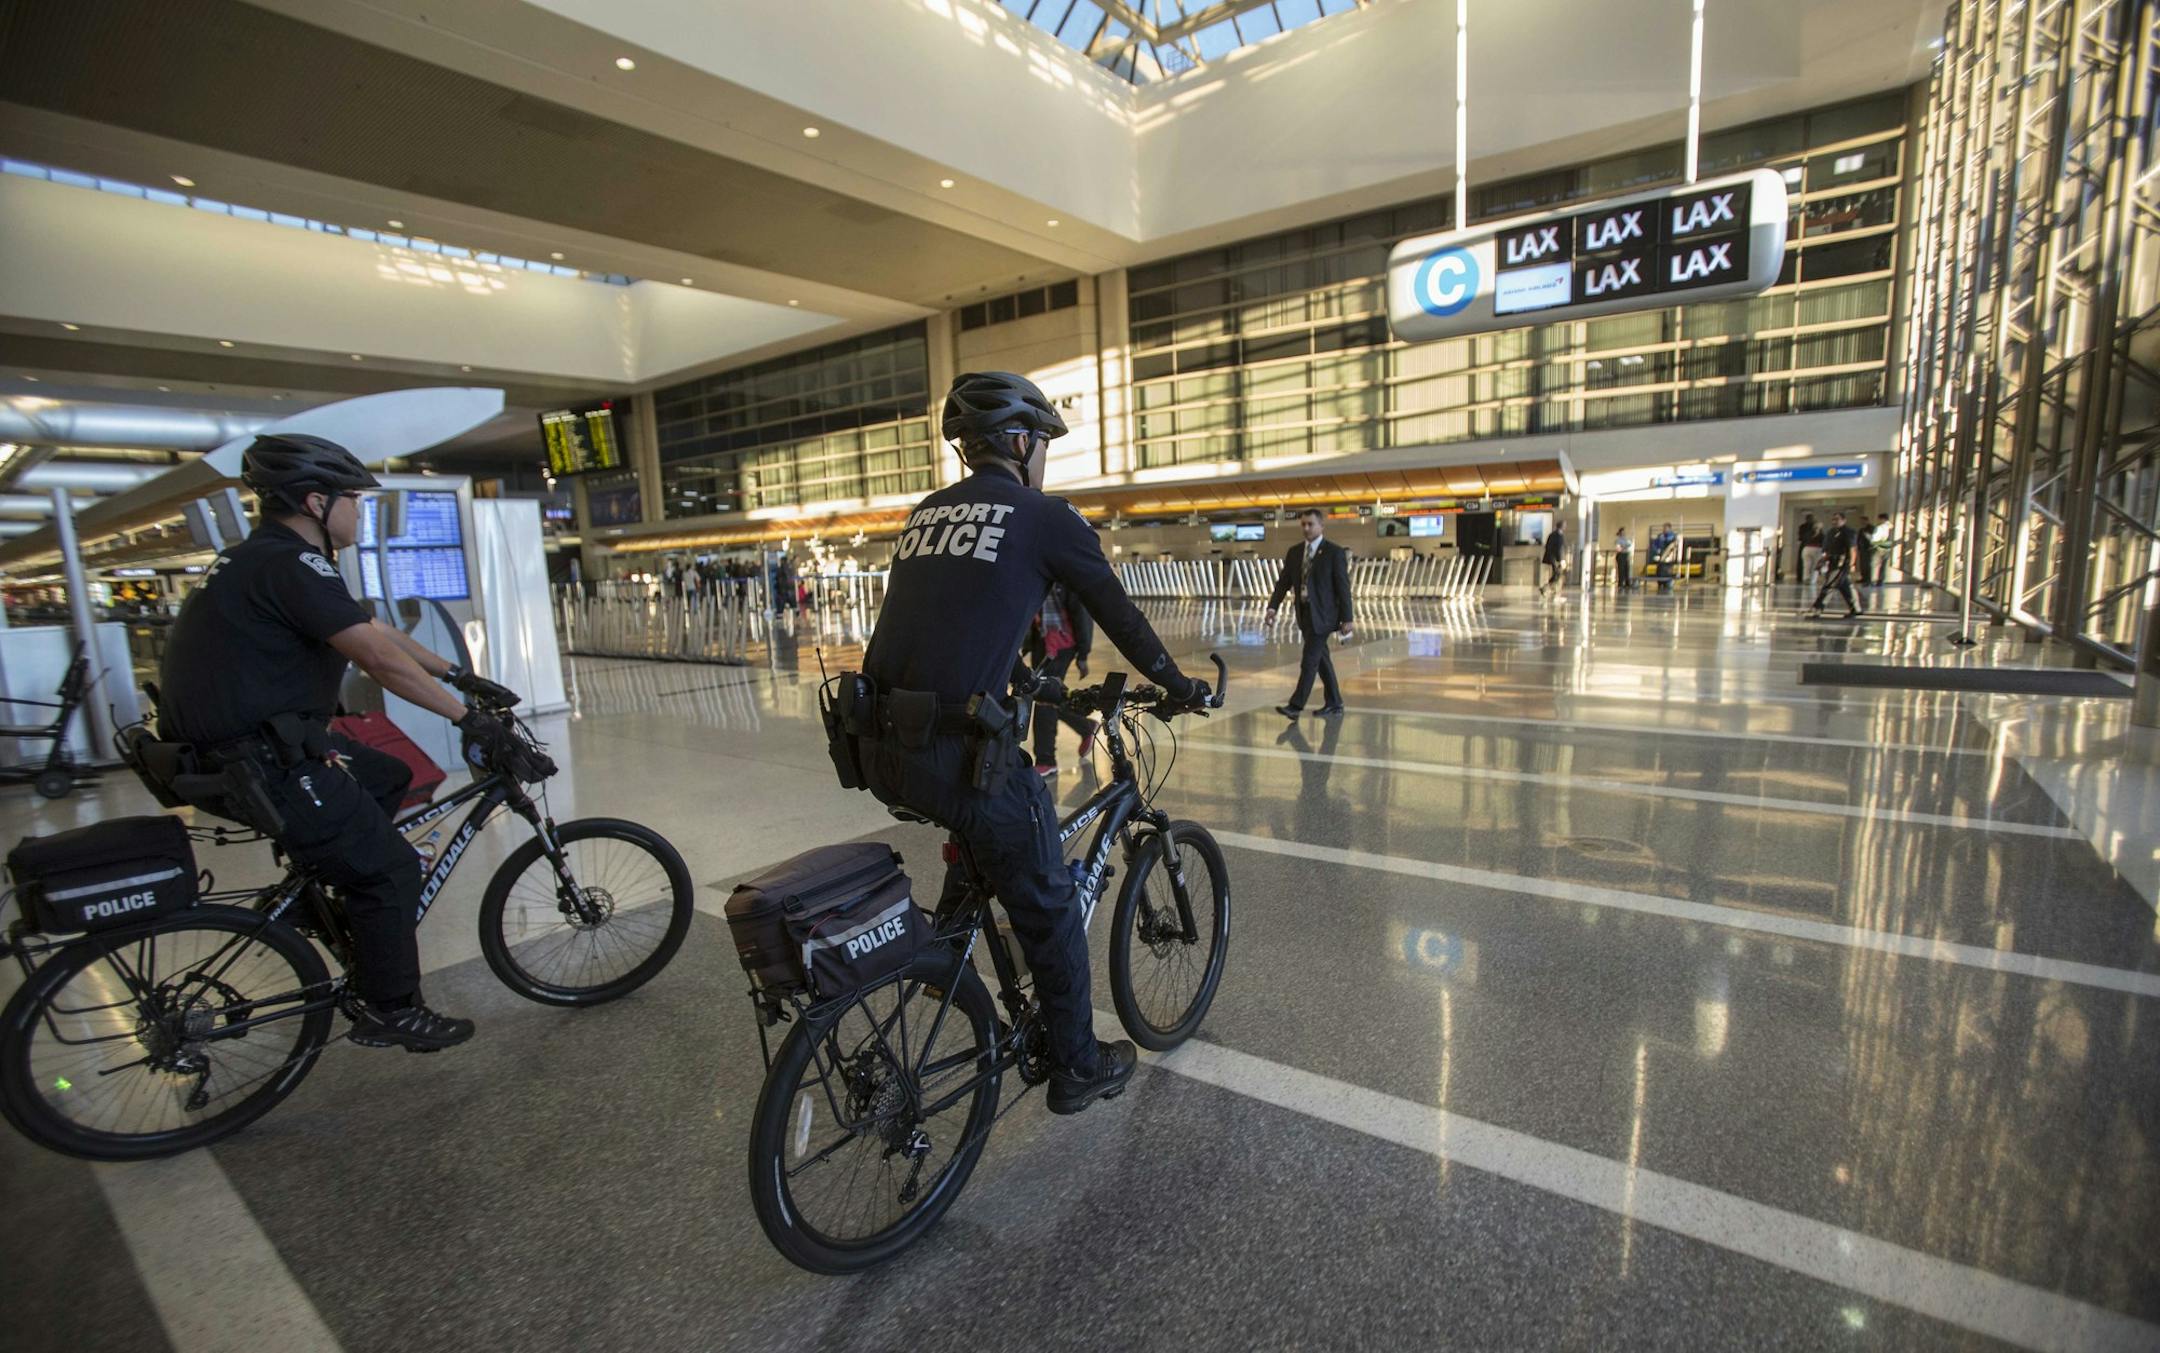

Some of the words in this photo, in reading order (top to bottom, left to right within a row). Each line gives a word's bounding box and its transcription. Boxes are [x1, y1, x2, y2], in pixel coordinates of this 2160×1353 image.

[1586, 210, 1643, 250] LAX
[1673, 192, 1735, 235] LAX
[1507, 226, 1560, 264] LAX
[1670, 242, 1731, 284] LAX
[1426, 255, 1467, 308] C
[1585, 257, 1641, 297] LAX
[83, 891, 157, 921] POLICE
[846, 916, 906, 960] POLICE
